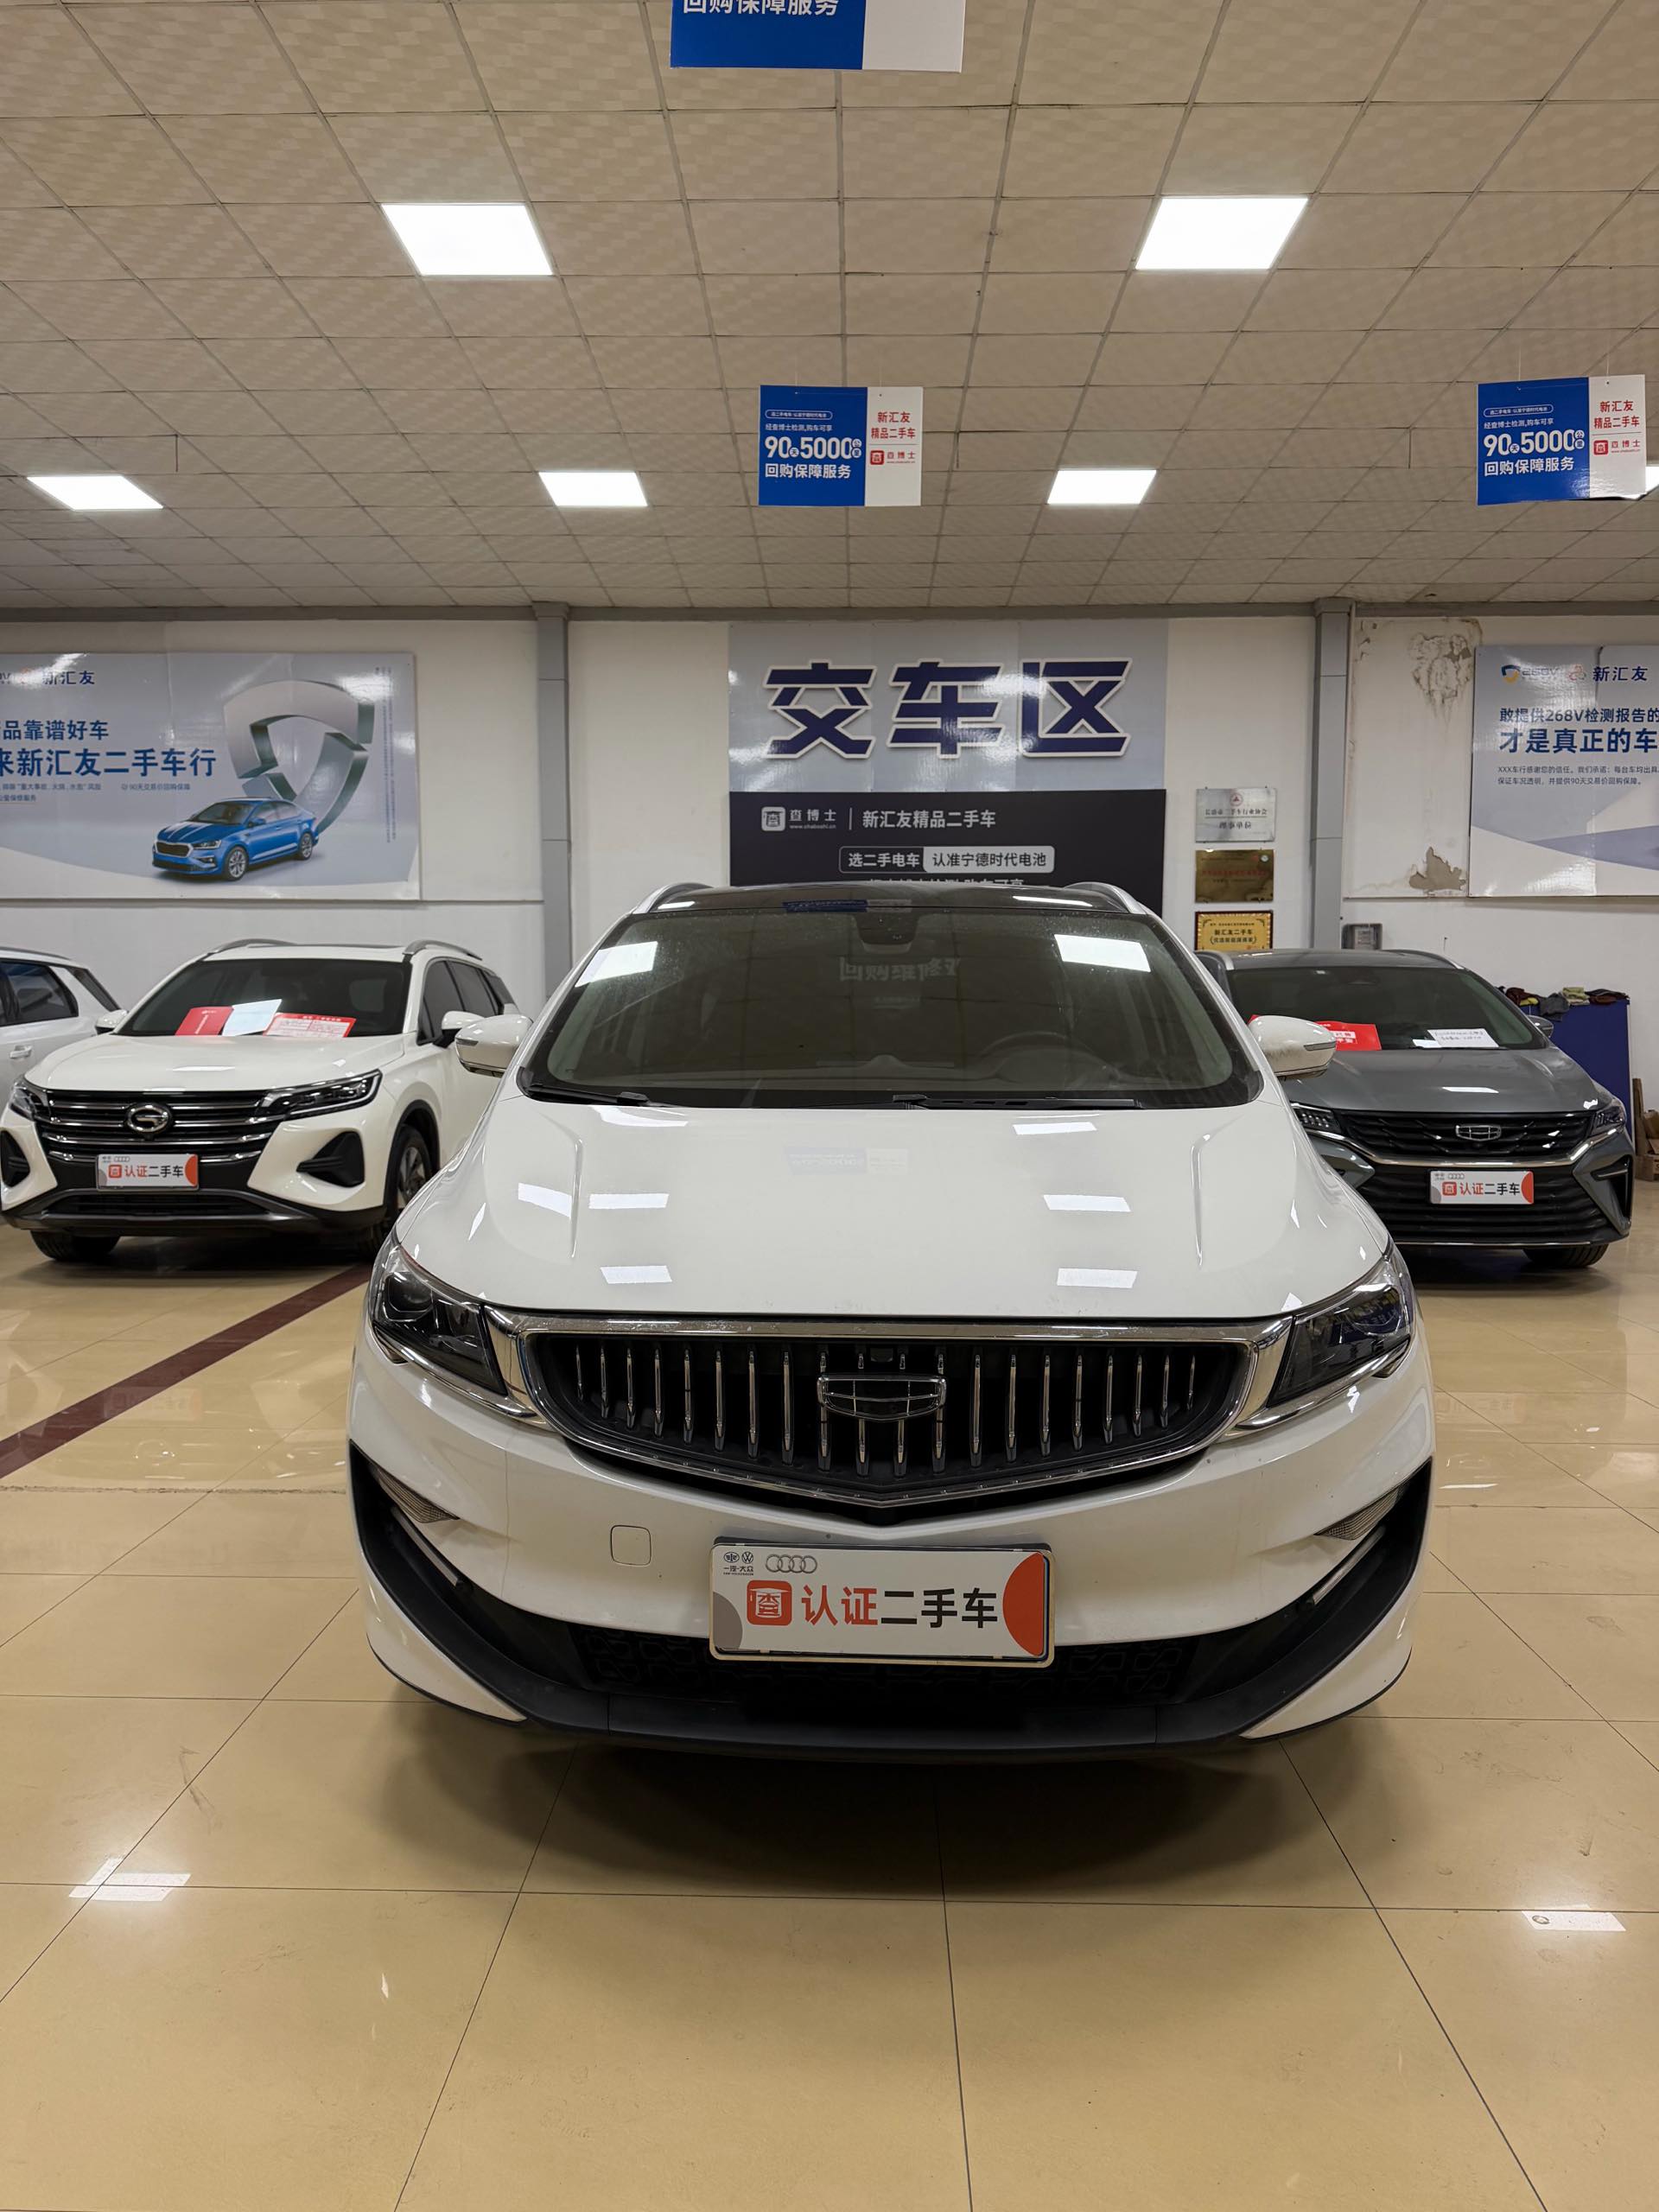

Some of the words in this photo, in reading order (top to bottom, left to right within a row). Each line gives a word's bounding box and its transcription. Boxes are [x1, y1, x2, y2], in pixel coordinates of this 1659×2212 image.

[683, 0, 838, 15] 回购保障服务
[1599, 400, 1634, 413] 新汇友
[877, 411, 911, 423] 新汇友
[1593, 416, 1640, 429] 精品二手车
[871, 428, 916, 440] 精品二手车
[765, 463, 851, 478] 回购保障服务
[1484, 456, 1574, 477] 回购保障服务
[1592, 666, 1648, 682] 新汇友
[762, 658, 1132, 759] 交车区
[1499, 708, 1659, 723] 敢提供268V检测报告的
[0, 720, 109, 741] 品靠谱好车
[1499, 728, 1658, 753] 才是真正的车
[0, 747, 216, 778] 来新汇友二手车行
[788, 809, 836, 822] 查博士
[862, 810, 996, 830] 新汇友精品二手车
[847, 852, 920, 868] 选二手电车
[932, 851, 1046, 868] 认准宁德时代电池
[124, 1165, 184, 1178] 认证二手车
[1459, 1182, 1521, 1196] 认证二手车
[801, 1584, 998, 1629] 认证二手车
